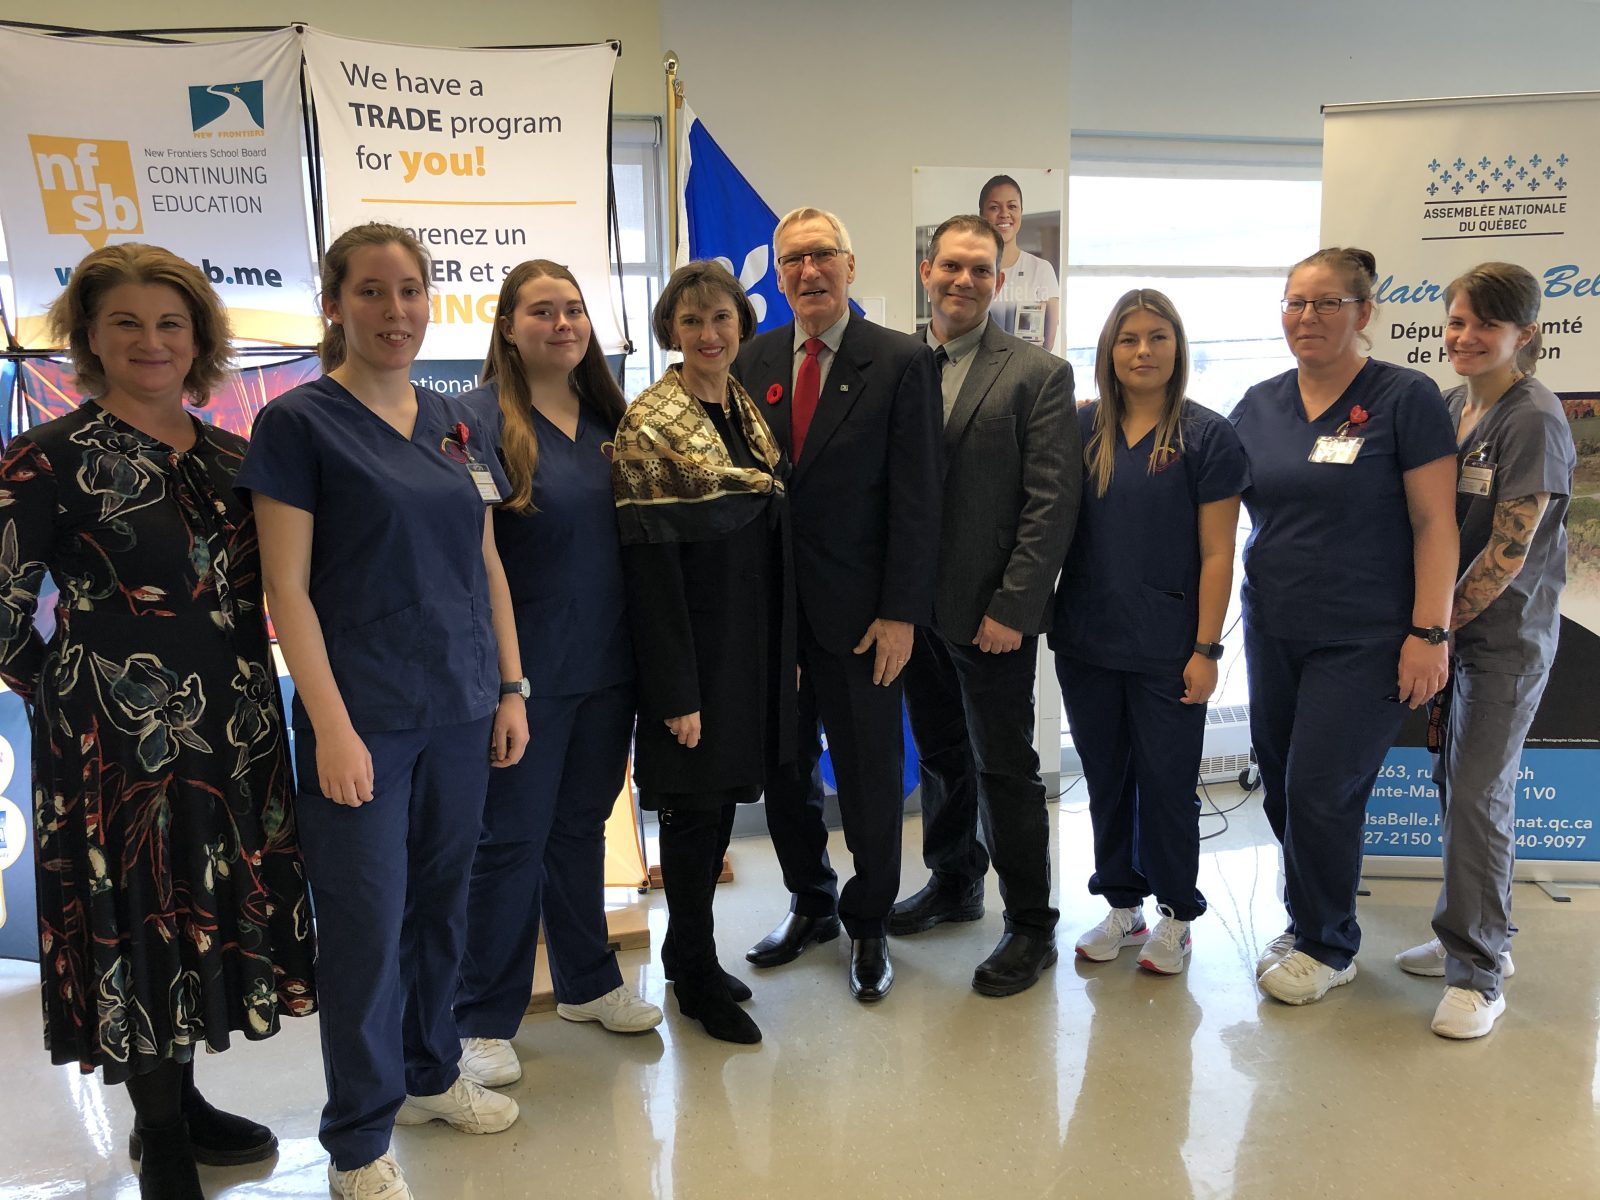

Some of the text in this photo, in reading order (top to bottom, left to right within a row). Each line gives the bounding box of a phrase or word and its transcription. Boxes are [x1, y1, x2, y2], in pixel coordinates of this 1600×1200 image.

[340, 61, 484, 96] We have a
[348, 102, 562, 139] TRADE program
[144, 148, 267, 158] New Frontiers School Board
[356, 145, 486, 183] for you!
[147, 166, 268, 184] CONTINUING
[152, 195, 262, 213] EDUCATION
[1424, 203, 1566, 219] ASSEMBLÉE NATIONALE
[1459, 217, 1527, 232] DU QUÉBEC
[495, 228, 526, 245] un
[469, 262, 494, 282] et
[1373, 273, 1443, 304] lair
[1391, 322, 1445, 342] Dépu
[1407, 347, 1432, 364] de
[1417, 769, 1432, 778] ru
[1523, 787, 1556, 800] 1V0
[1364, 831, 1431, 845] 27-2150
